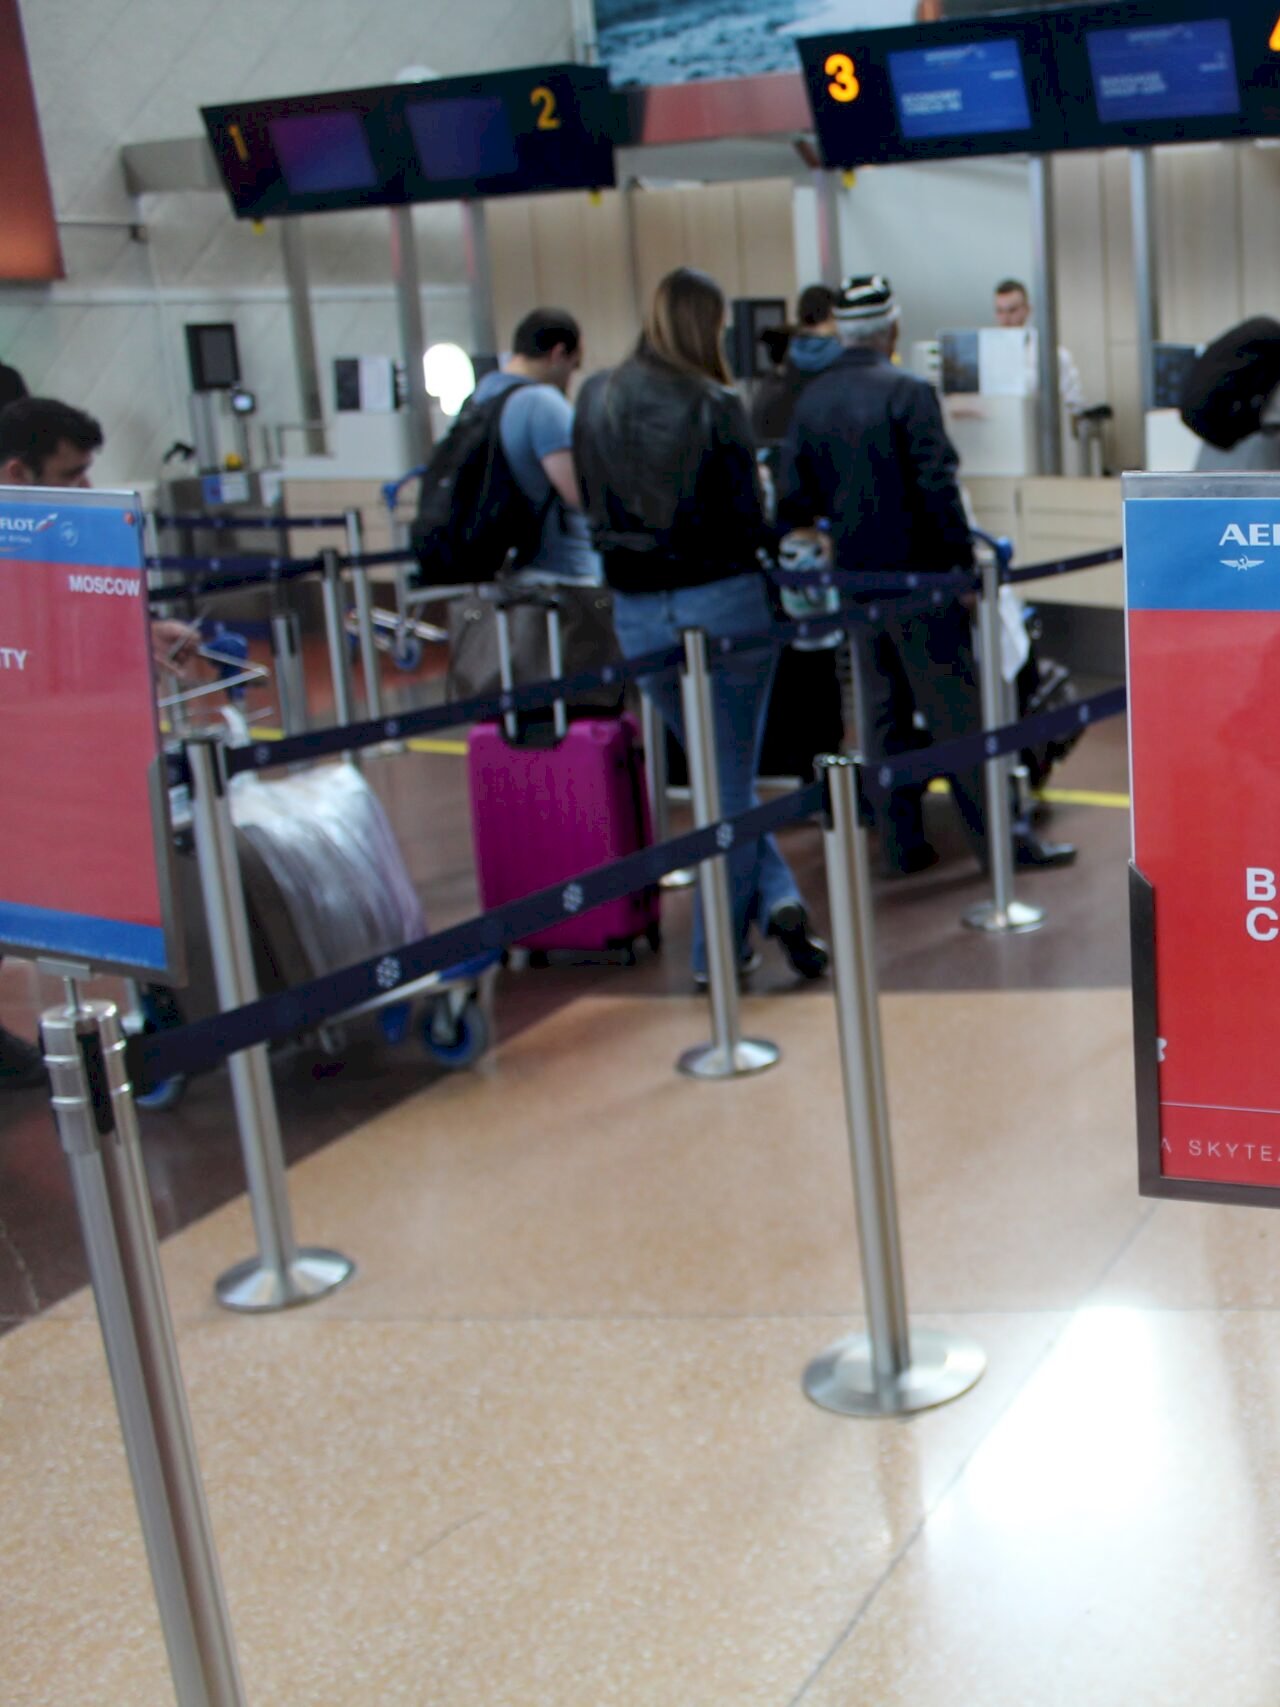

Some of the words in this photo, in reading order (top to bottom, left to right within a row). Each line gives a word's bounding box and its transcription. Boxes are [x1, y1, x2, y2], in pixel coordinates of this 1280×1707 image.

[823, 53, 860, 103] 3
[530, 86, 561, 130] 2
[228, 123, 250, 162] 1
[68, 573, 141, 597] MOSCOW
